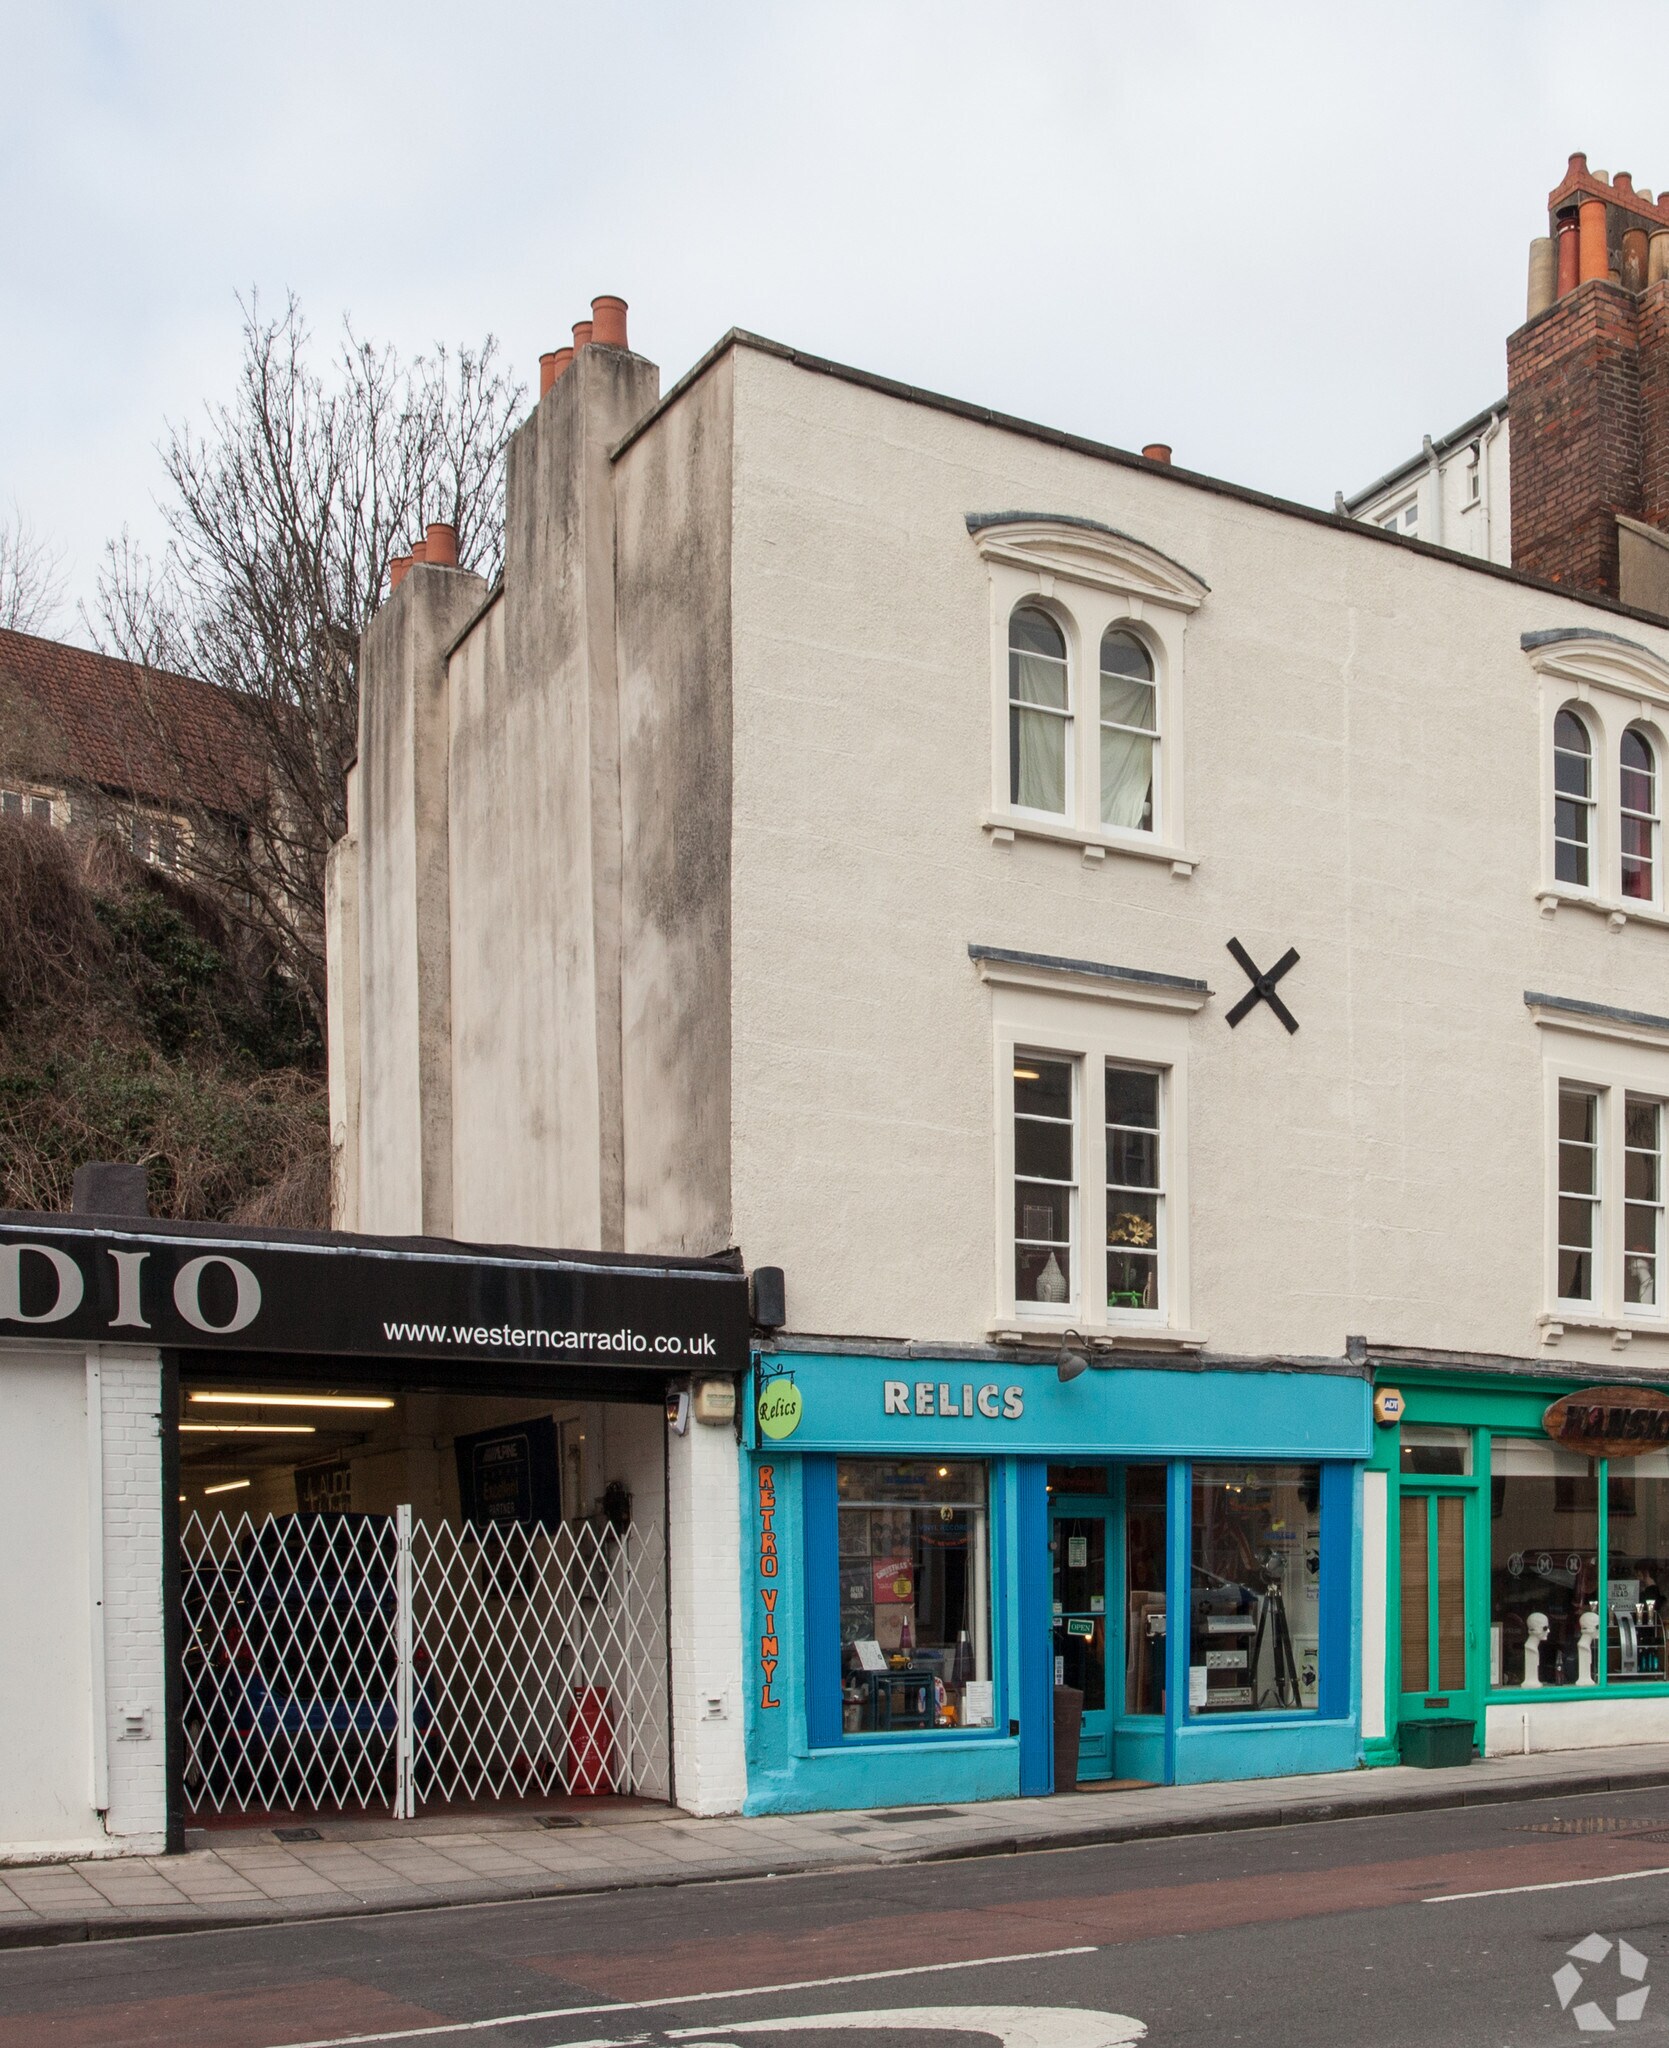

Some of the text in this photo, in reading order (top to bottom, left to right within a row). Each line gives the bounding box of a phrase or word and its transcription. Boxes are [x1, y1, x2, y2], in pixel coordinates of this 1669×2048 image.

[383, 1322, 717, 1355] www.westerncarradio.co.uk
[759, 1397, 796, 1421] Relics
[883, 1380, 1025, 1420] RELICS
[1385, 1398, 1399, 1411] ADT
[757, 1465, 781, 1710] RETRO VINYL
[1071, 1623, 1090, 1632] OPEN
